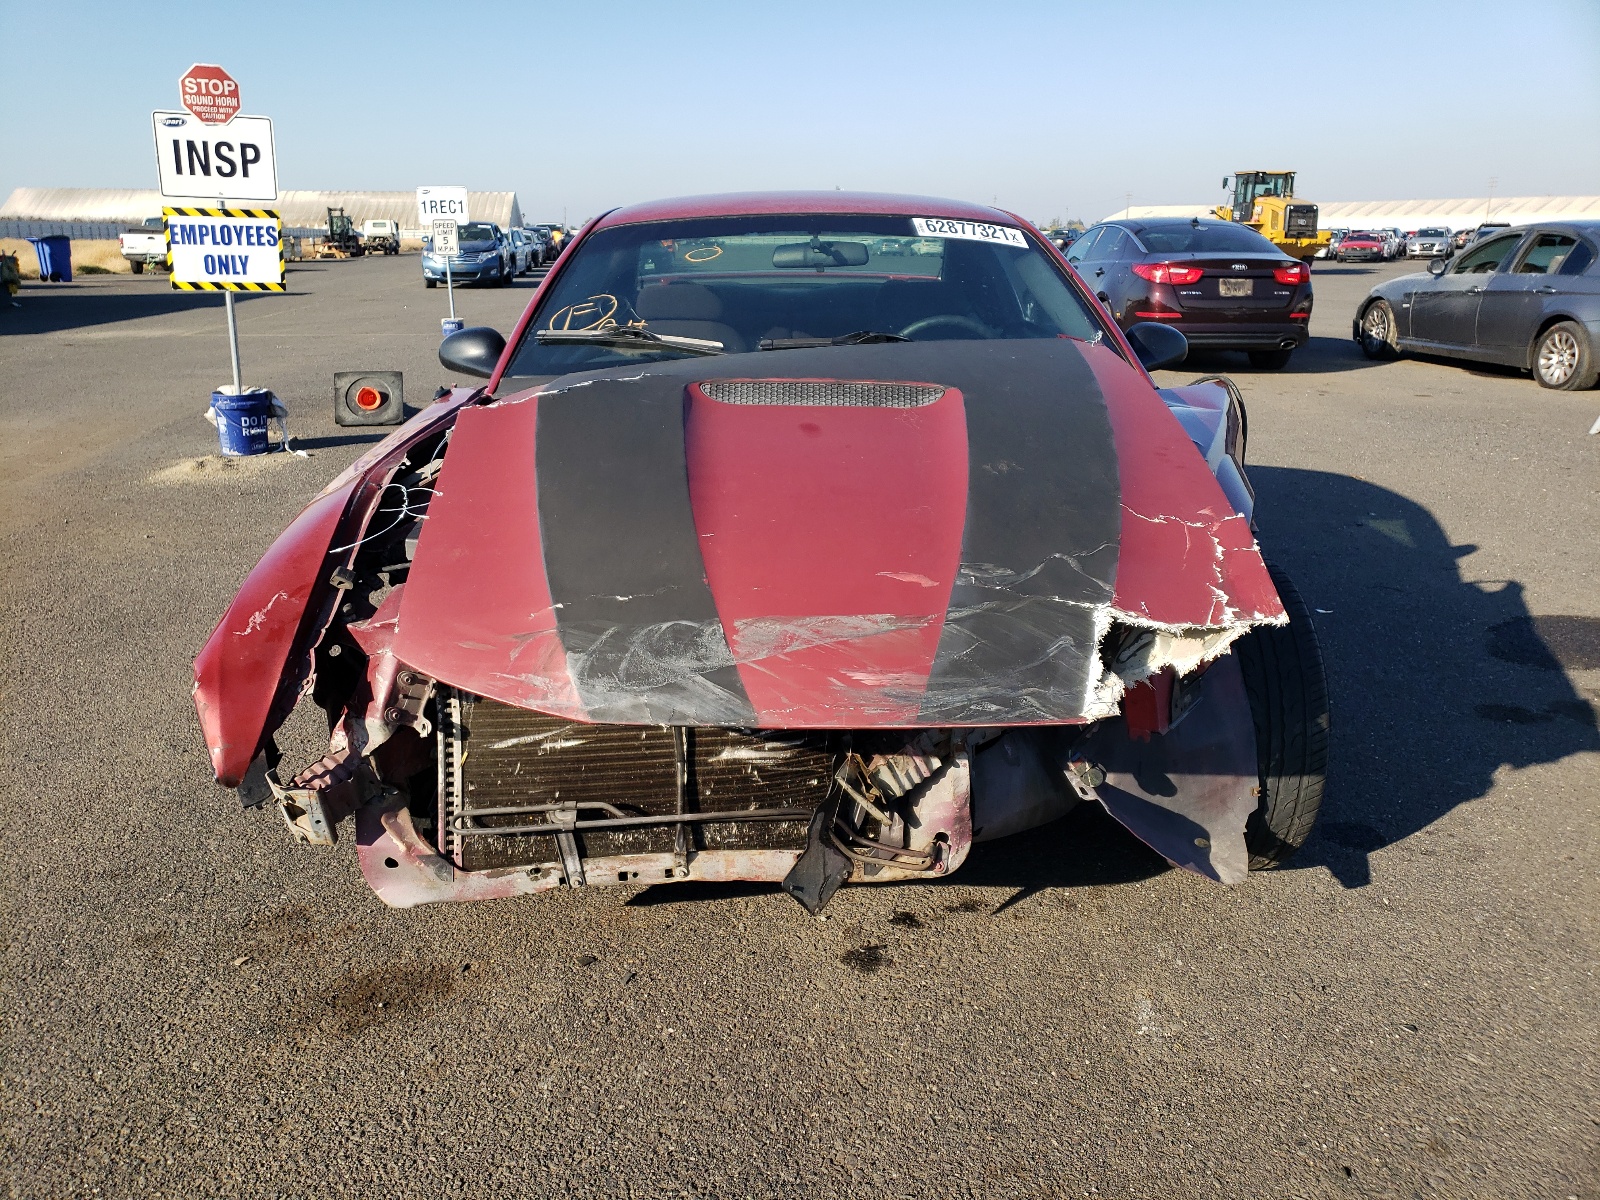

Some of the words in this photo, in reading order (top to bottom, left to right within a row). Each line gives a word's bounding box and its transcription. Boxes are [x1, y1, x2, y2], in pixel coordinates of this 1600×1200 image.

[184, 77, 236, 95] STOP
[185, 94, 214, 106] SOUND
[215, 96, 238, 107] HORN
[192, 105, 218, 113] PROCEED
[218, 106, 234, 114] WITH
[201, 112, 226, 120] CAUTION
[172, 139, 262, 178] INSP
[421, 199, 464, 214] 1REC1
[169, 223, 279, 247] EMPLOYEES
[925, 219, 1010, 241] 62877321
[443, 236, 449, 245] 5
[203, 254, 249, 275] ONLY
[241, 416, 258, 427] DO
[260, 415, 267, 425] IT
